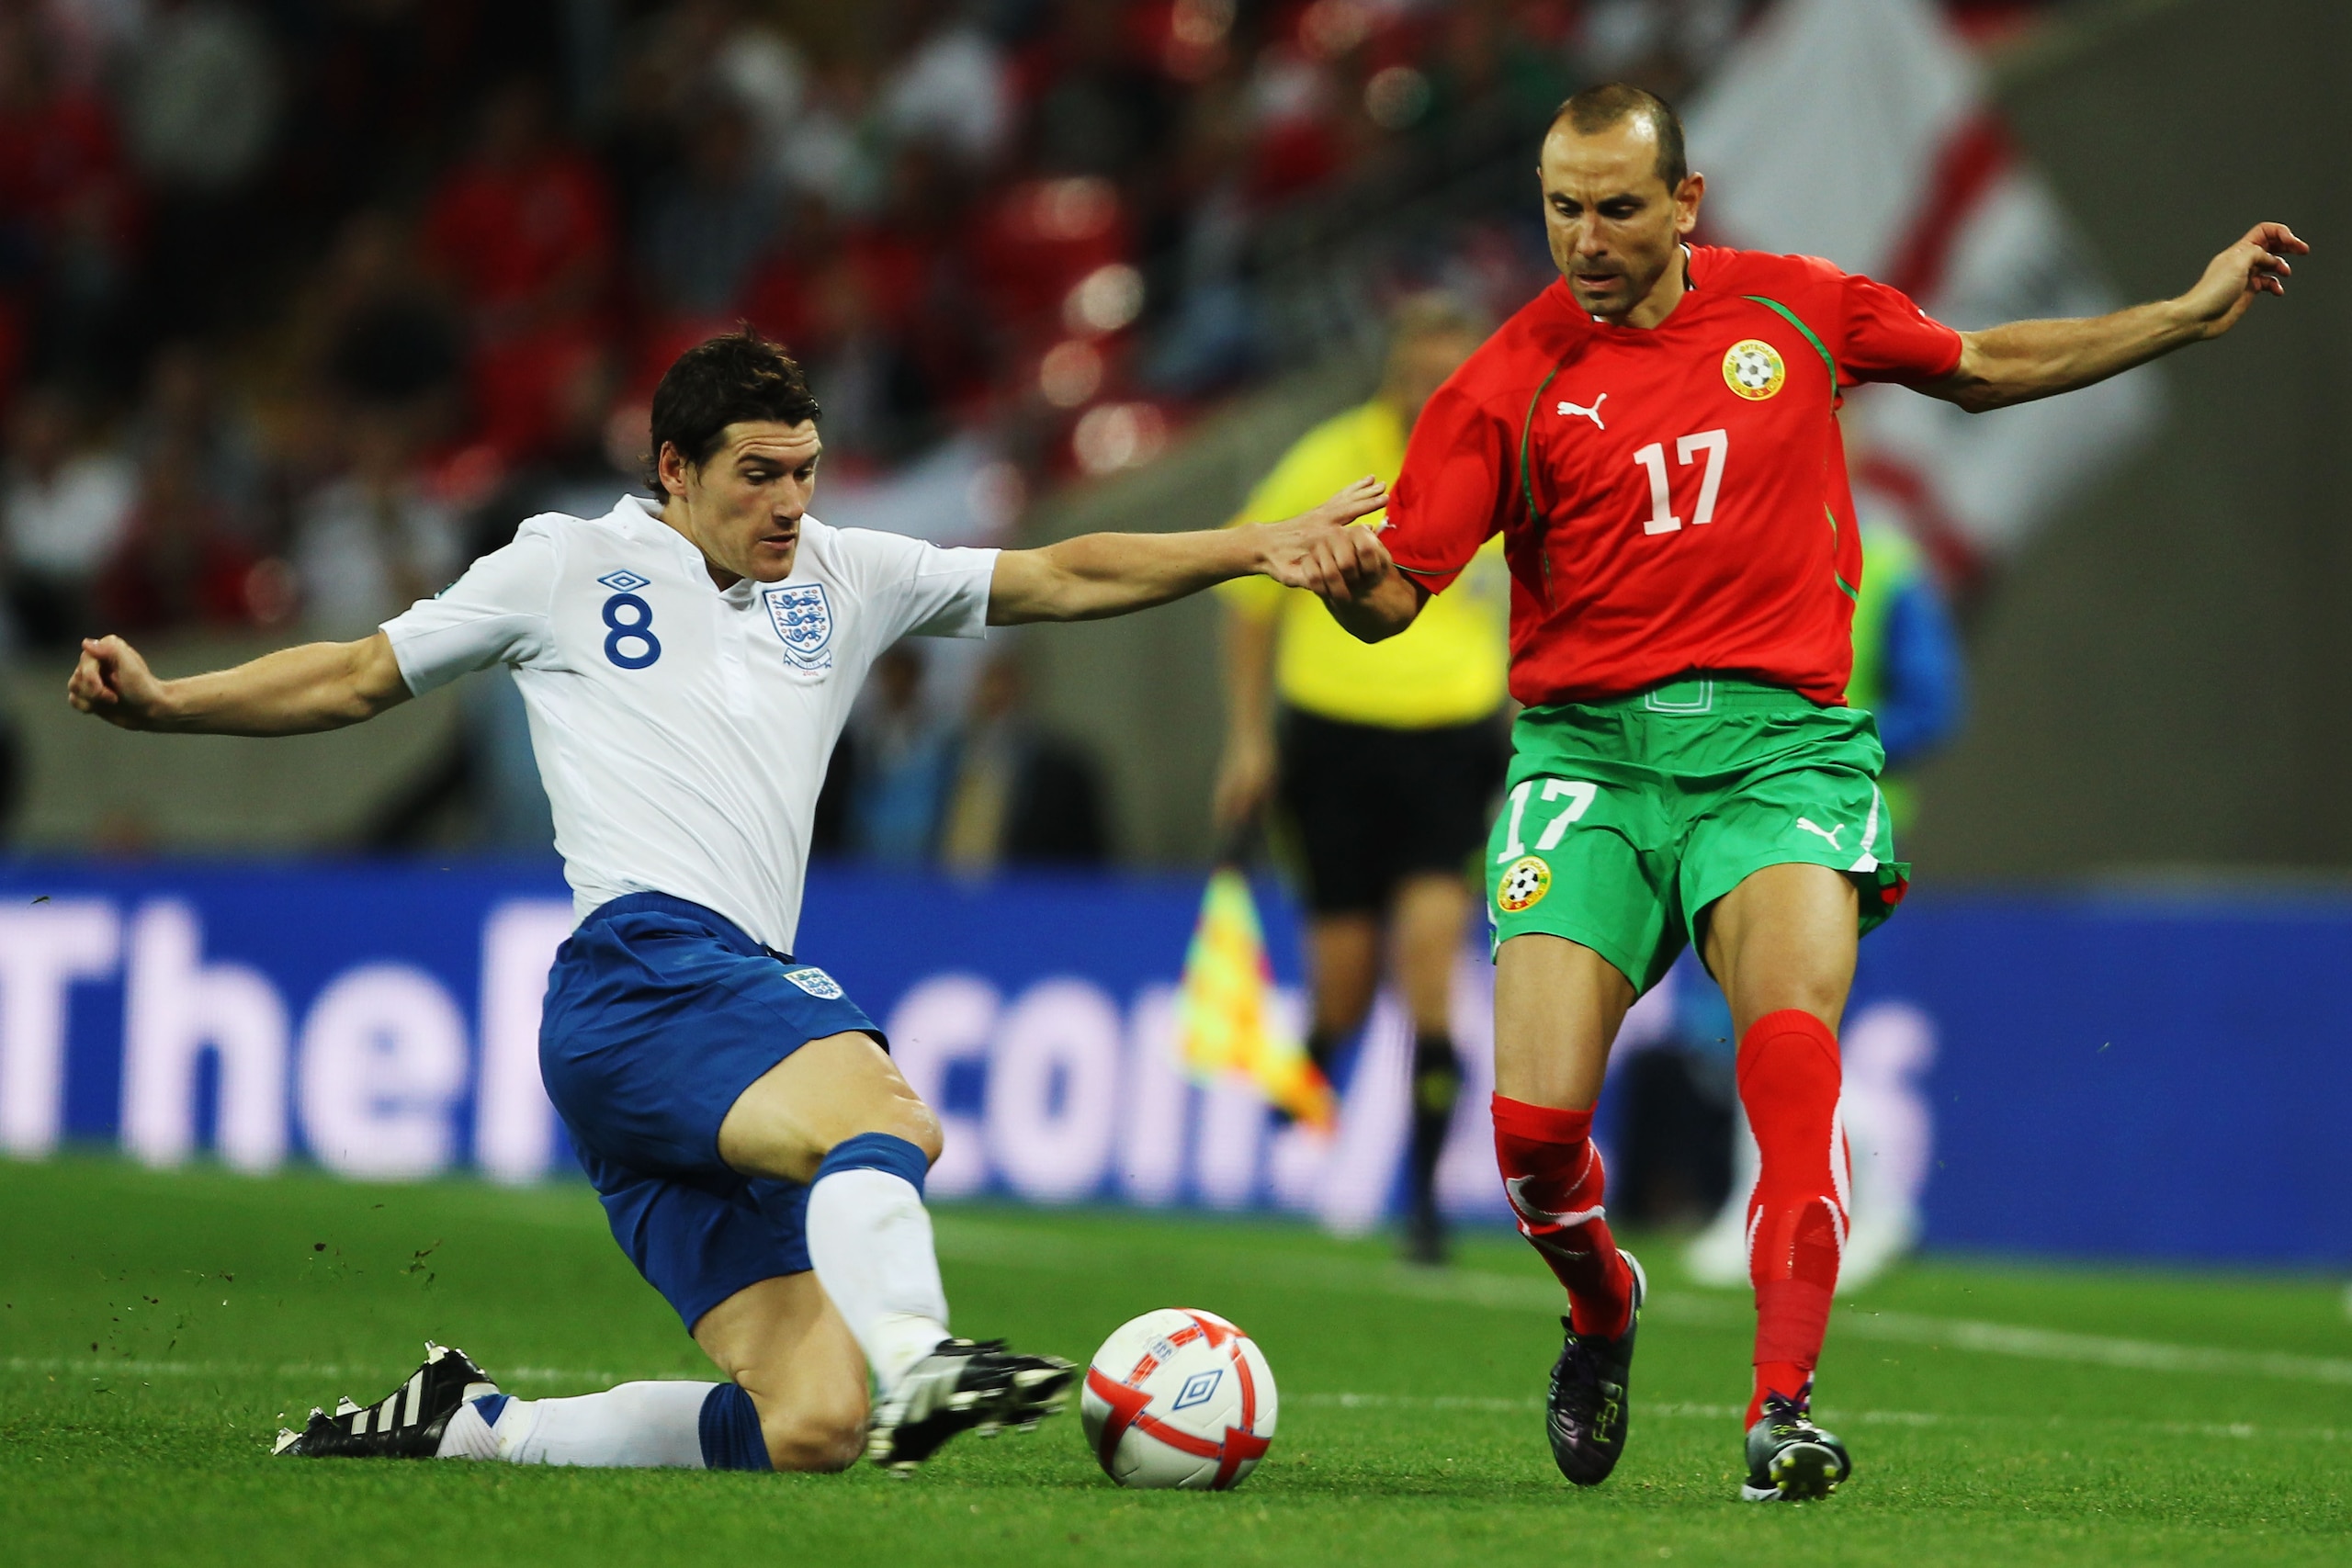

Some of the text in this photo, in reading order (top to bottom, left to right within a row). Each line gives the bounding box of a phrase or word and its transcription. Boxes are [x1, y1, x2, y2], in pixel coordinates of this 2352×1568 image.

[1633, 428, 1728, 536] 17
[602, 592, 662, 670] 8
[1497, 777, 1599, 864] 17
